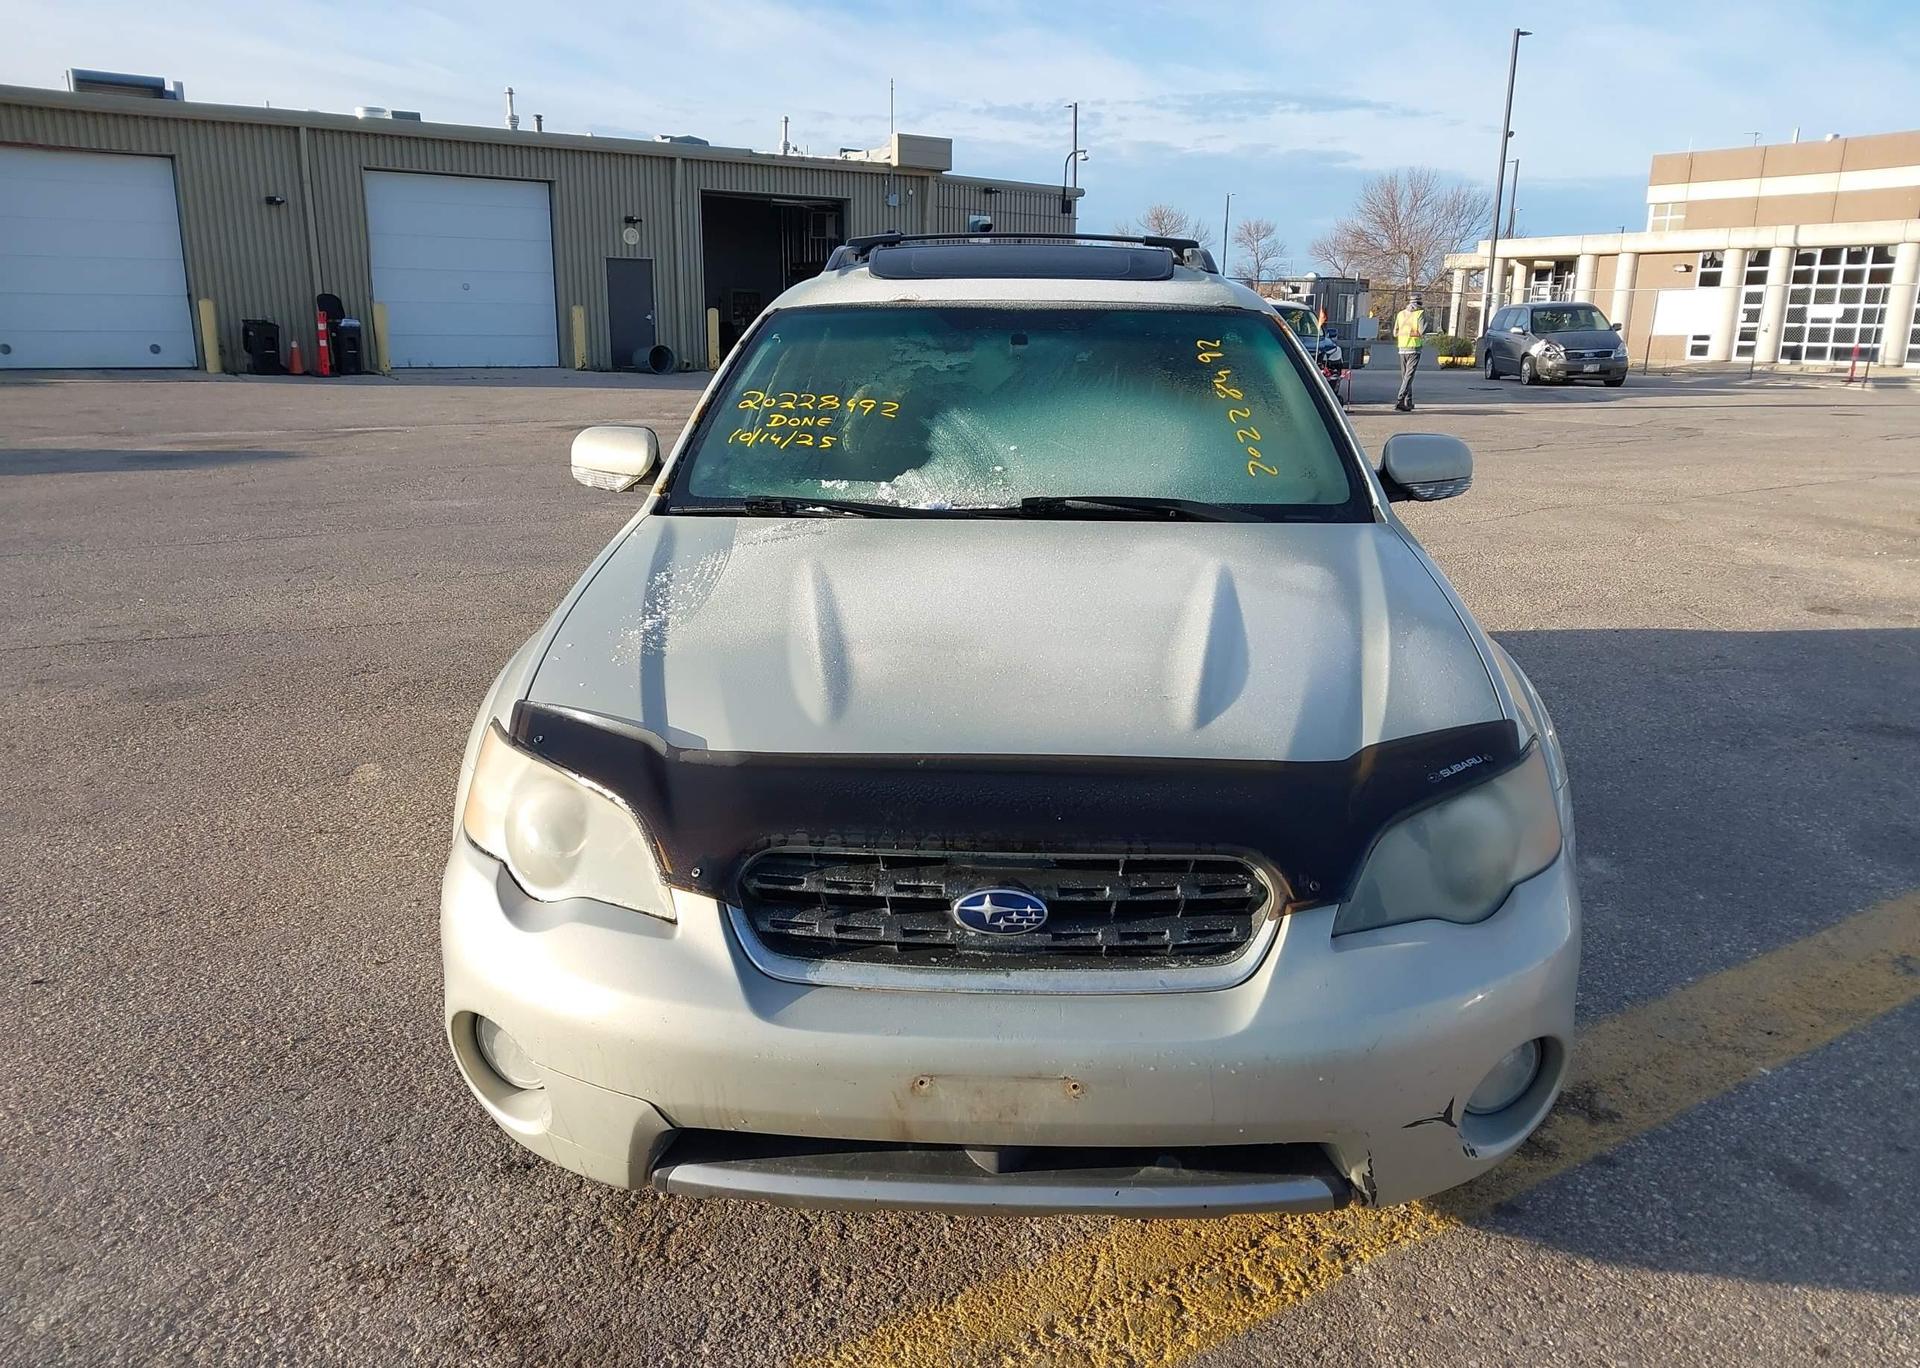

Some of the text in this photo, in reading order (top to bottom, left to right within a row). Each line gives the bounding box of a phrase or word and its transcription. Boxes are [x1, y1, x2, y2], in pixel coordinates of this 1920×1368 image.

[766, 414, 833, 427] DONE
[728, 427, 837, 449] 10/14/25
[1440, 756, 1483, 777] SUBARU
